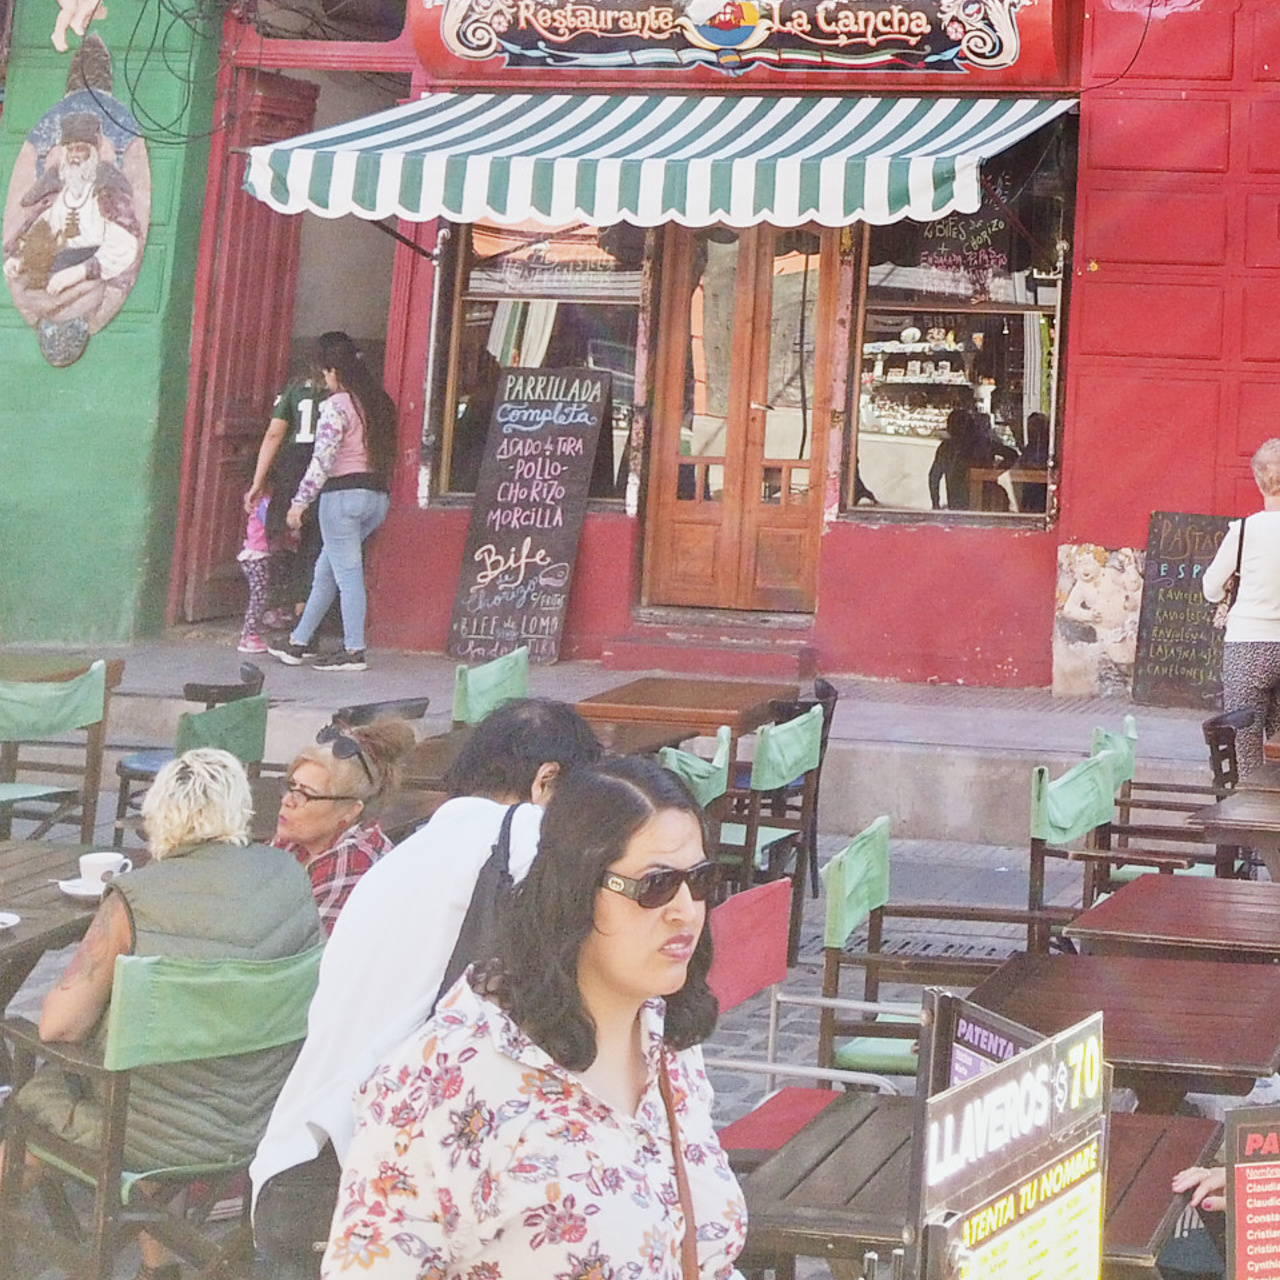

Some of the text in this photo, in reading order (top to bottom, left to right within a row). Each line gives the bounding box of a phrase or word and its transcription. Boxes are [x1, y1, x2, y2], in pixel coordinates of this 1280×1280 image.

[770, 1, 932, 45] La Cancha
[504, 375, 602, 402] PARRILLADA
[497, 403, 597, 431] Completa
[497, 437, 541, 458] ASADO
[557, 436, 583, 457] TIRA
[487, 506, 563, 531] MORCILLA
[957, 1018, 1014, 1061] PATENTA
[927, 1063, 1050, 1187] LLAVEROS
[1246, 1167, 1280, 1179] Nombre
[962, 1193, 1015, 1248] ATENTA
[1019, 1177, 1039, 1215] TU
